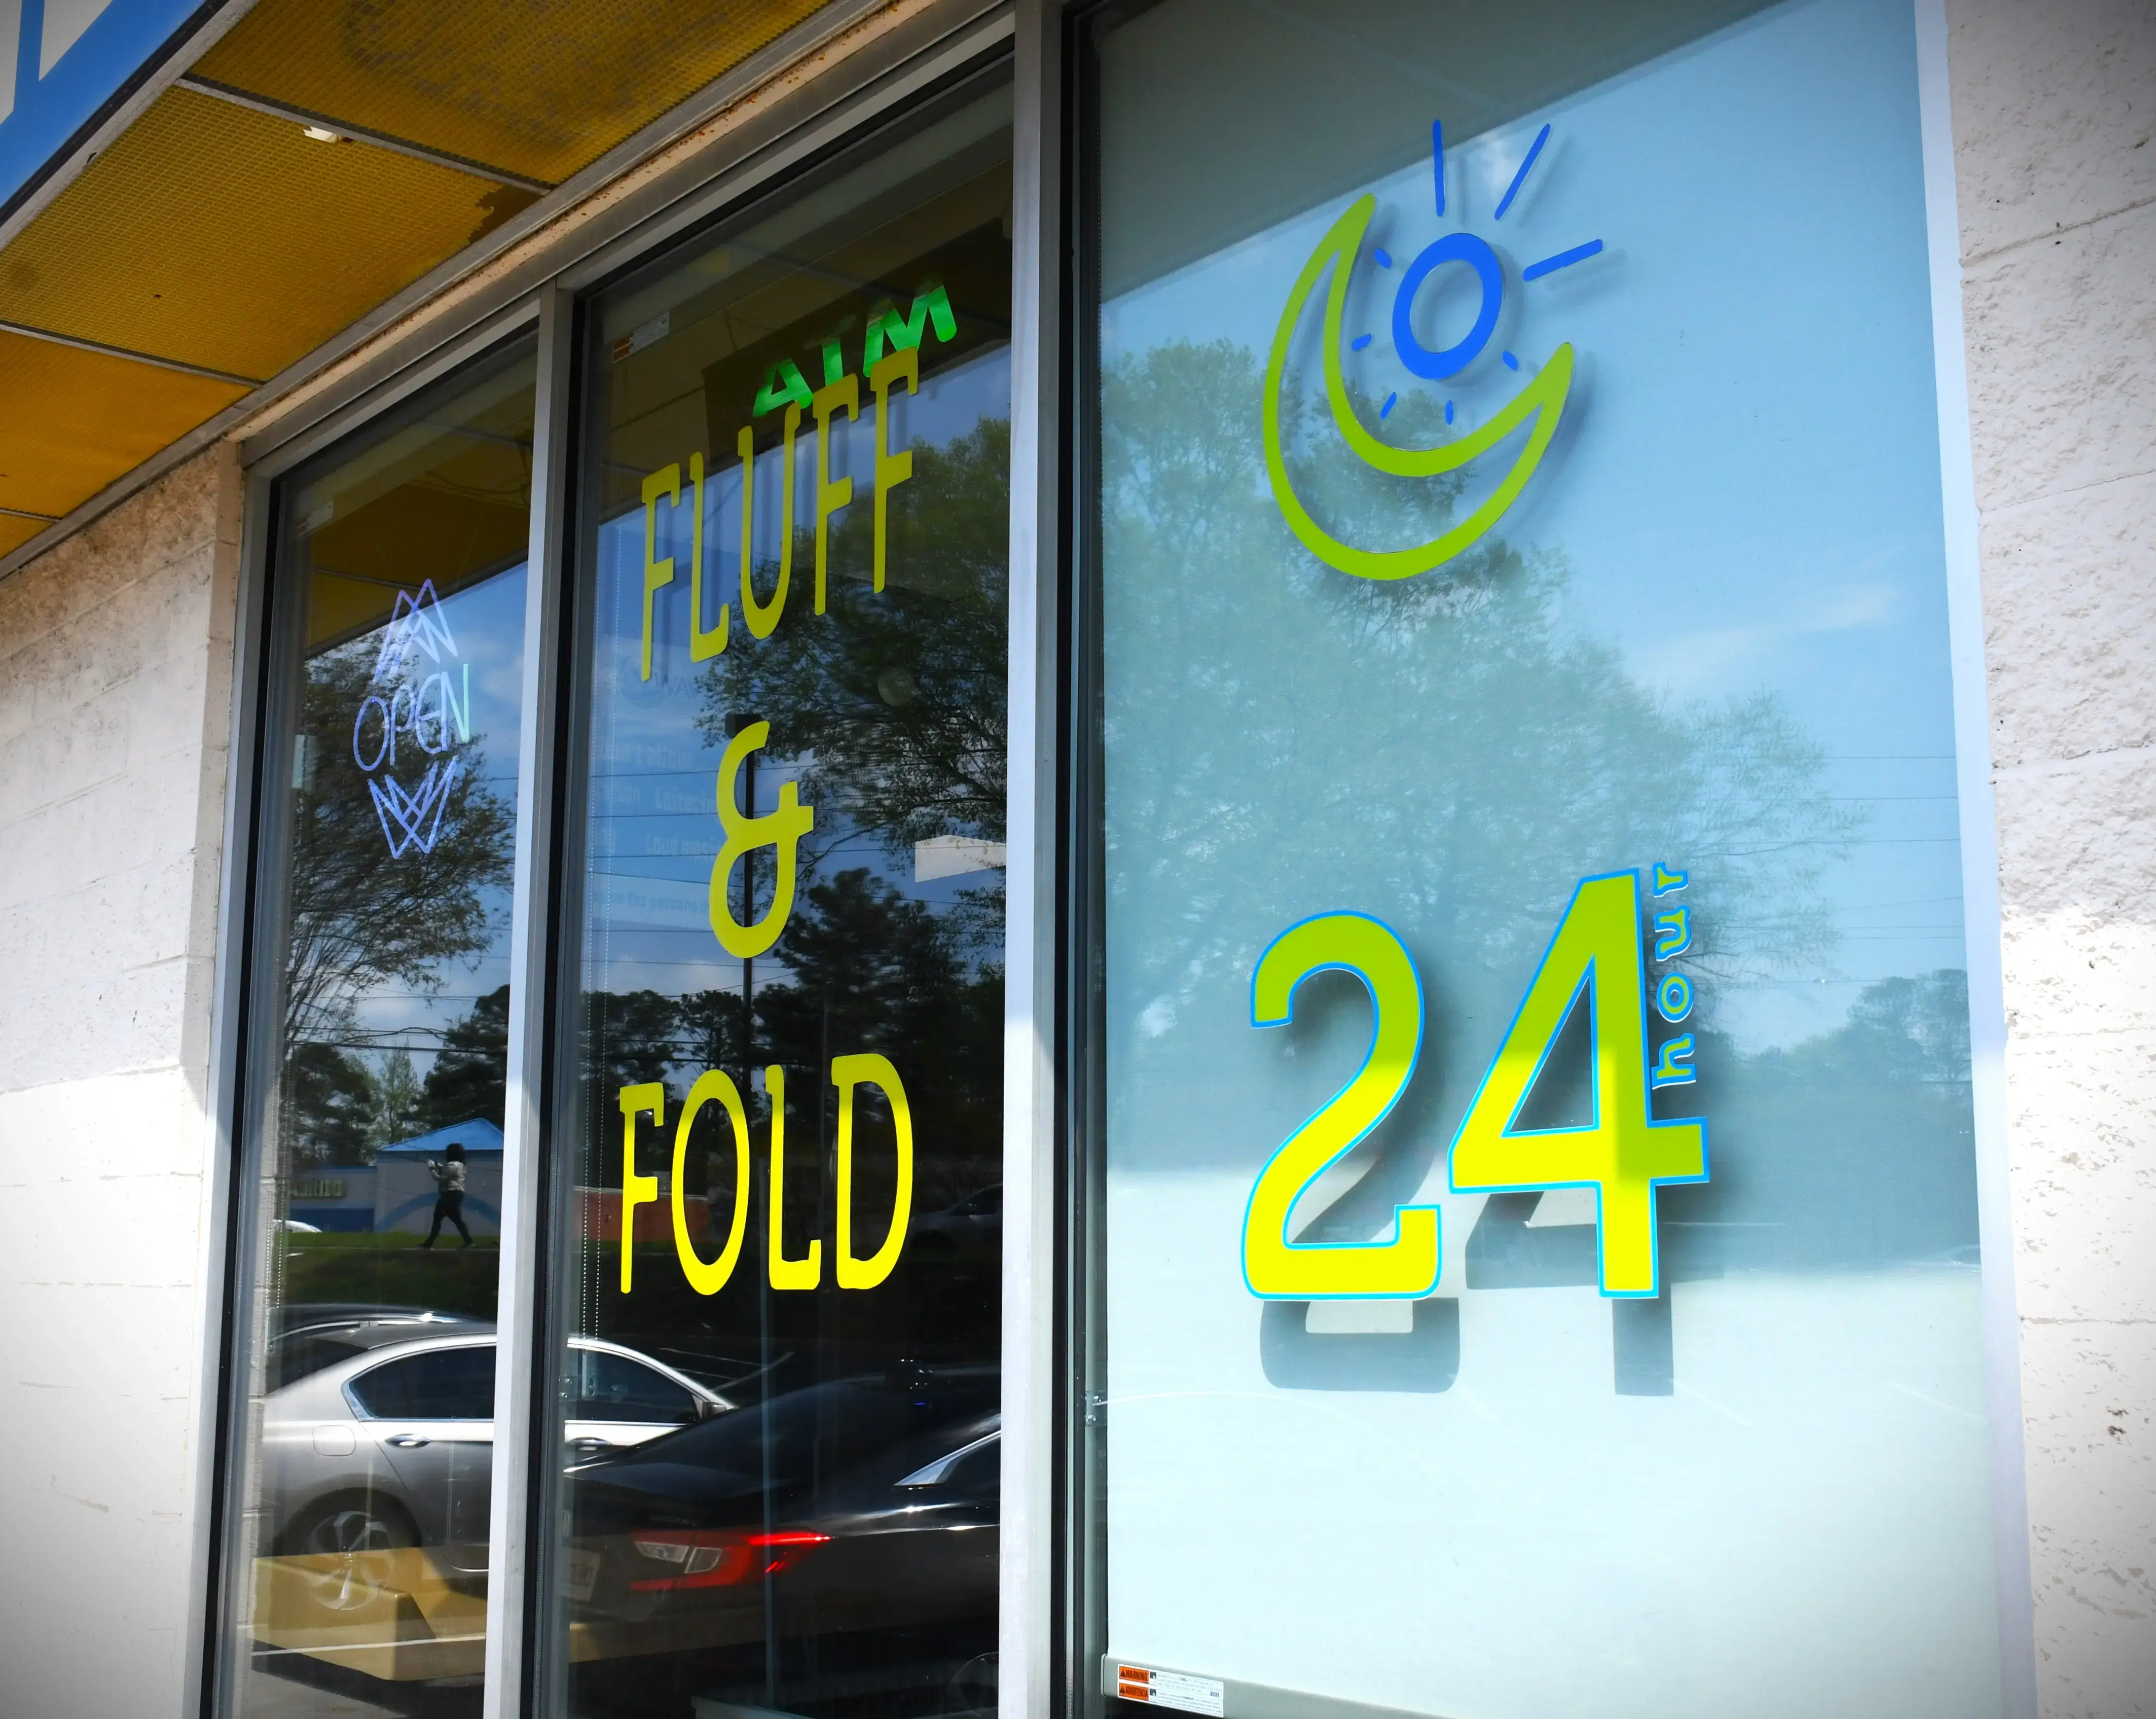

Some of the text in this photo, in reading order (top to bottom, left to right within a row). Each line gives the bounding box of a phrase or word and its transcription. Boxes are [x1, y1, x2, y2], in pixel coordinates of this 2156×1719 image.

[752, 274, 957, 418] ATM
[641, 346, 919, 682] FLUFF
[353, 663, 470, 772] OPEN
[709, 720, 814, 959] &
[1240, 867, 1710, 1301] 24
[1651, 862, 1697, 1090] hour
[619, 1053, 913, 1296] FOLD
